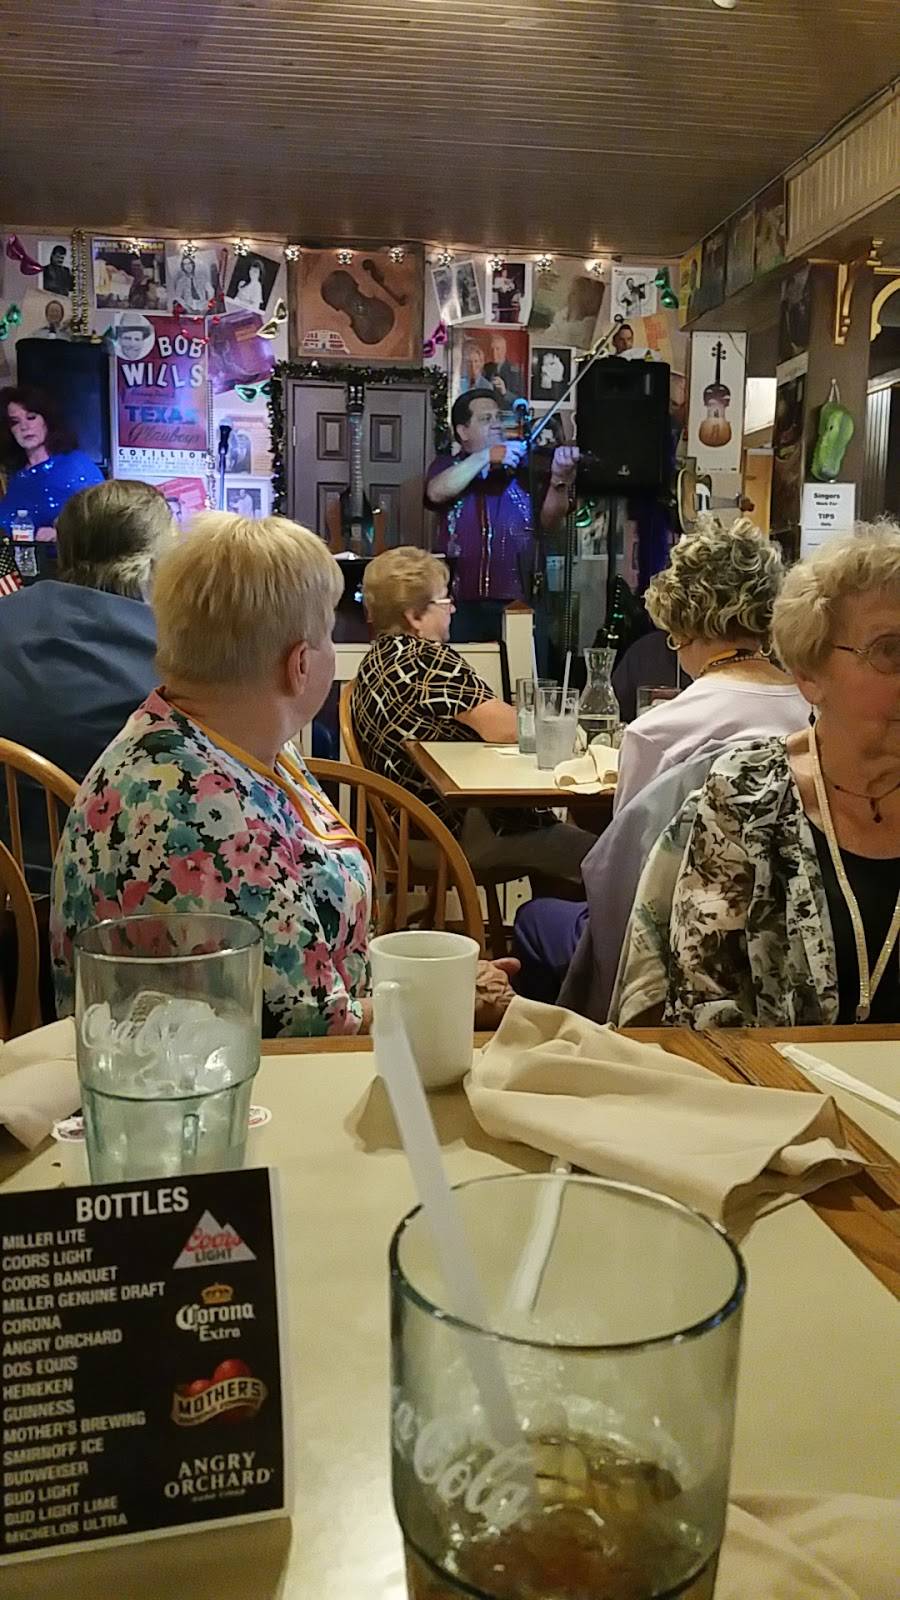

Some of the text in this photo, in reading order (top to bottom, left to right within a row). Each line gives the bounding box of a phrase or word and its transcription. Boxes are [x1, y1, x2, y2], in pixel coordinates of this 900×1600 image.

[157, 334, 203, 358] BOB
[121, 362, 204, 388] WILLS
[124, 405, 198, 425] TEXAS
[118, 448, 208, 459] COTILLION
[813, 492, 840, 500] Singers
[76, 1187, 189, 1223] BOTTLES
[2, 1228, 86, 1250] MILLER LITE
[2, 1248, 94, 1272] COORS LIGHT
[194, 1248, 233, 1263] LIGHT
[2, 1266, 118, 1293] COORS BANQUET
[2, 1281, 166, 1314] MILLER GENUINE DRAFT
[2, 1315, 62, 1336] CORONA
[175, 1303, 255, 1332] Corona
[3, 1328, 123, 1357] ANGRY ORCHARD
[199, 1325, 241, 1343] Extra
[3, 1355, 78, 1379] DOS EQUIS
[3, 1378, 74, 1401] HEINEKEN
[3, 1398, 76, 1423] GUINNESS
[3, 1410, 147, 1445] MOTHER'S BREWING
[3, 1437, 105, 1467] SMIRNOFF ICE
[3, 1460, 89, 1487] BUDWEISER
[178, 1451, 256, 1479] ANGRY
[4, 1482, 80, 1507] BUD LIGHT
[163, 1467, 271, 1499] ORCHARD
[4, 1495, 119, 1526] BUD LIGHT LIME
[82, 1512, 128, 1531] ULTRA
